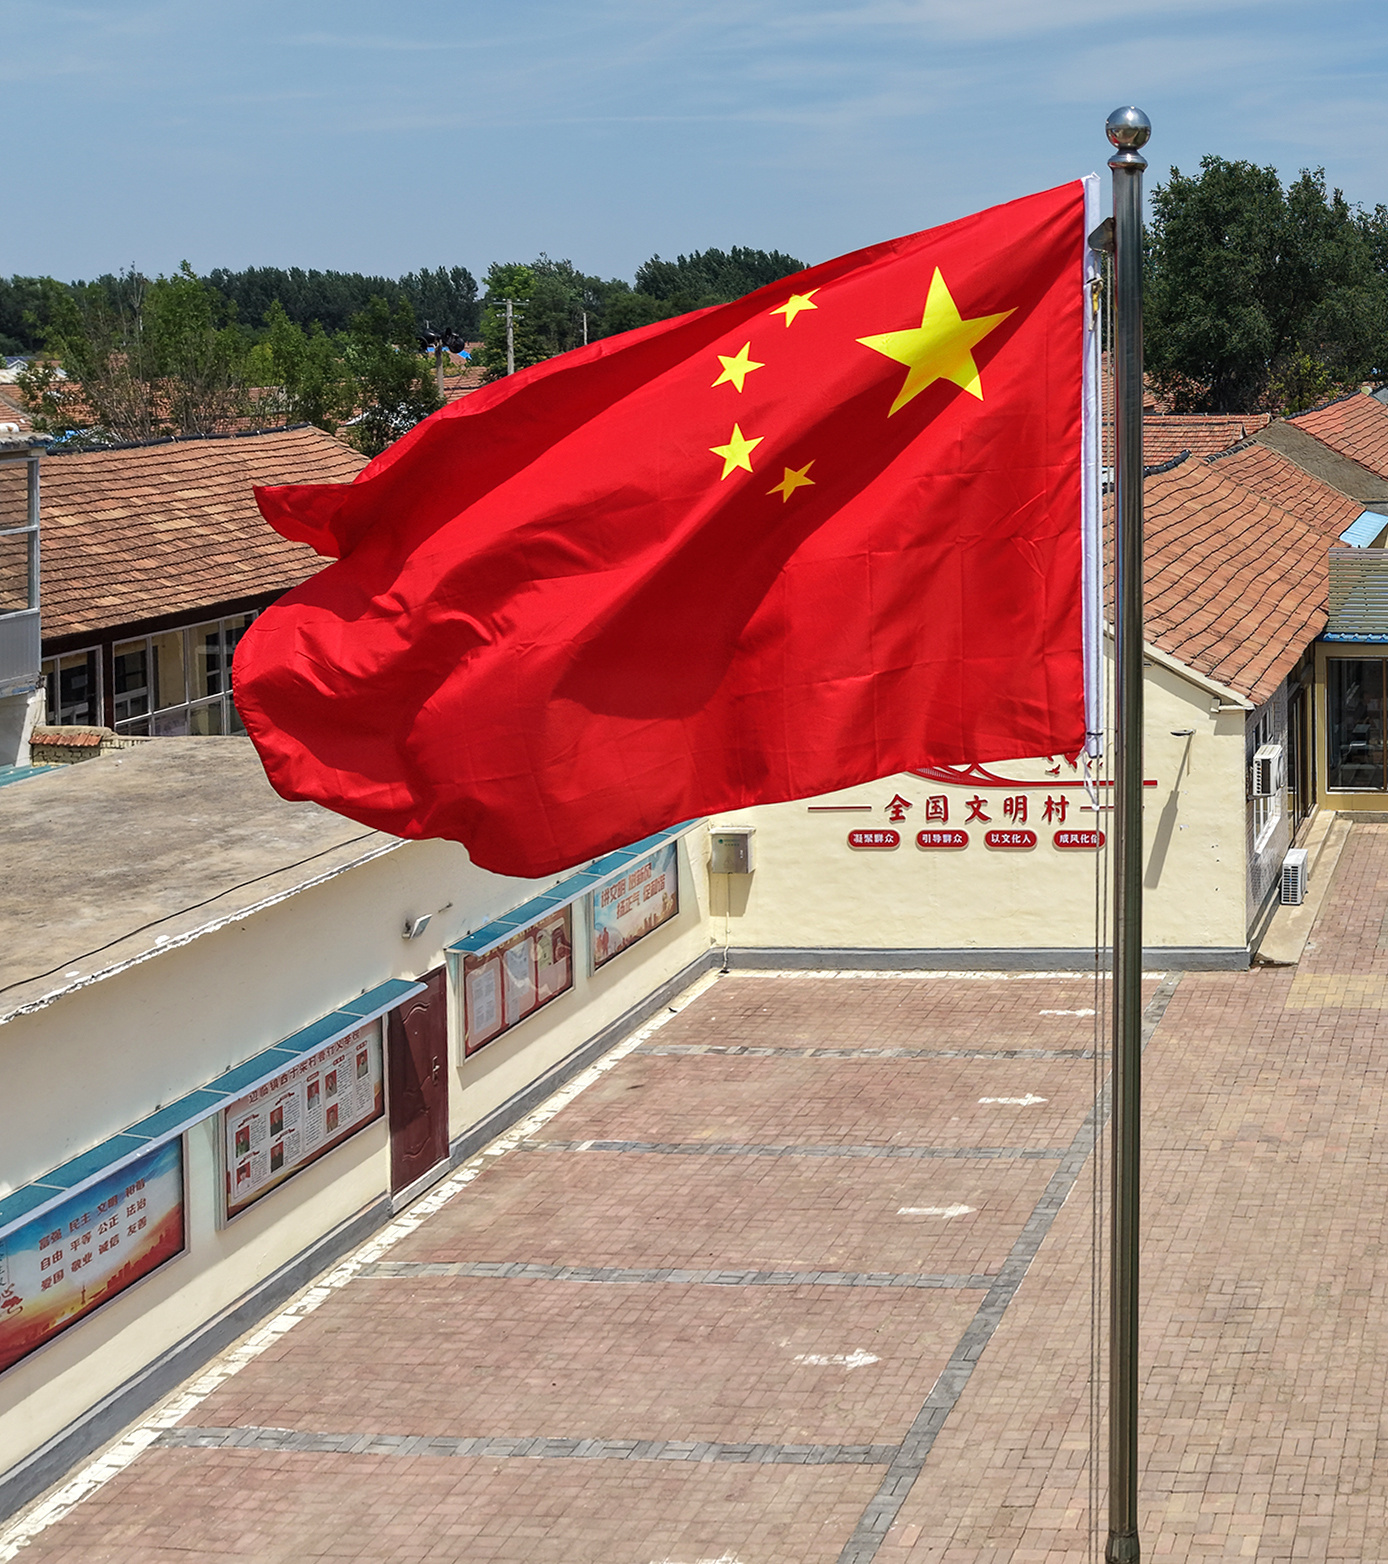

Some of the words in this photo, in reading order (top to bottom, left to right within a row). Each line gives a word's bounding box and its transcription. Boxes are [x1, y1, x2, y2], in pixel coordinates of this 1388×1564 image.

[885, 793, 1070, 823] 全国文明村
[853, 833, 894, 844] 凝聚群众
[922, 833, 963, 844] 引导群众
[991, 833, 1031, 844] 以文化人
[38, 1228, 62, 1250] 富强
[69, 1213, 91, 1233] 民主
[97, 1195, 118, 1215] 文明
[125, 1179, 146, 1198] 和谐
[40, 1250, 63, 1271] 自由
[70, 1234, 92, 1253] 平等
[98, 1216, 119, 1235] 公正
[126, 1198, 147, 1217] 法治
[41, 1270, 64, 1292] 爱国
[71, 1252, 93, 1273] 敬业
[98, 1236, 120, 1255] 诚信
[127, 1216, 147, 1237] 友善
